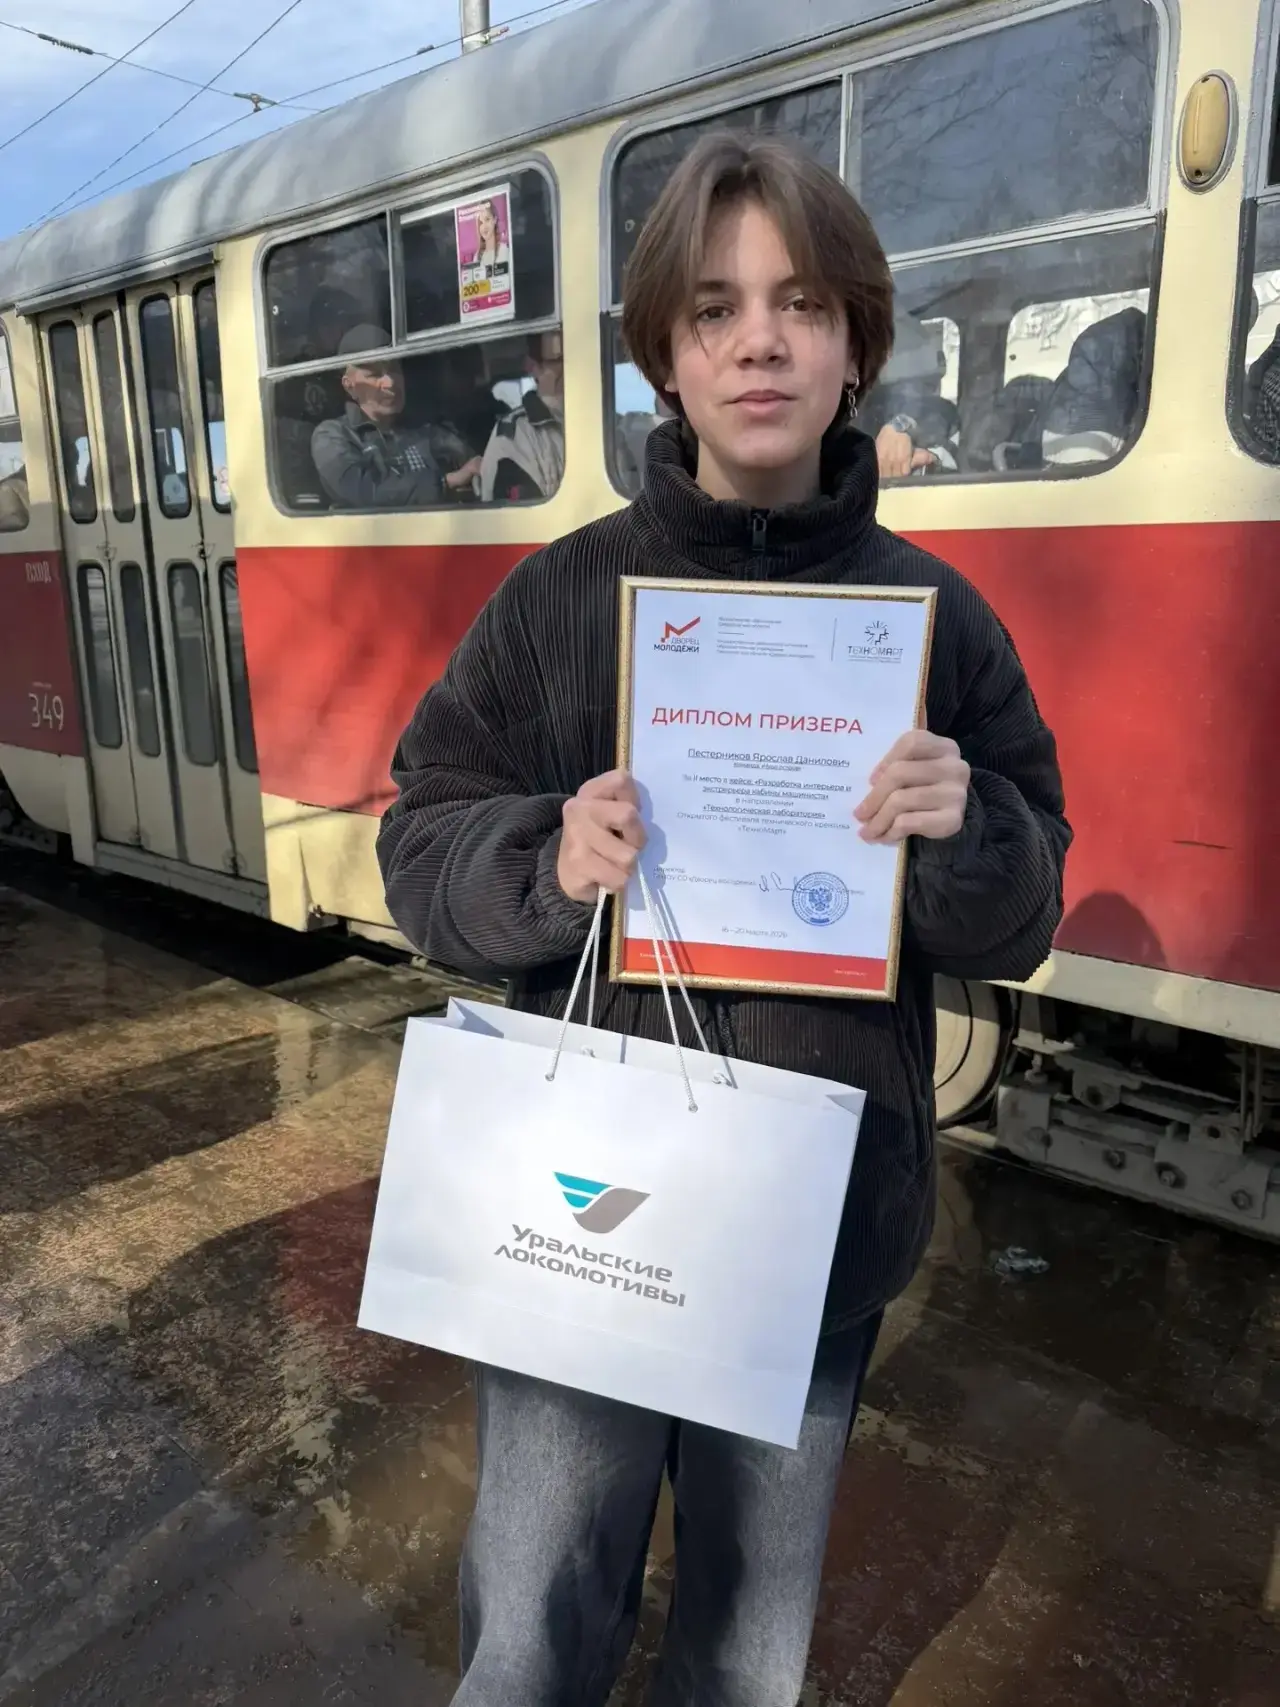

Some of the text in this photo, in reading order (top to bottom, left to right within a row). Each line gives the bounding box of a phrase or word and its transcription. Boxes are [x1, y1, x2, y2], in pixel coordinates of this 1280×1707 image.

[463, 283, 480, 297] 200
[671, 636, 700, 646] ДВОРЕЦ
[28, 692, 65, 731] 349
[652, 706, 863, 735] ДИПЛОМ ПРИЗЕРА
[687, 748, 850, 767] Пестерников Ярослав Данилович
[698, 775, 722, 784] место
[512, 1223, 674, 1284] Уральские
